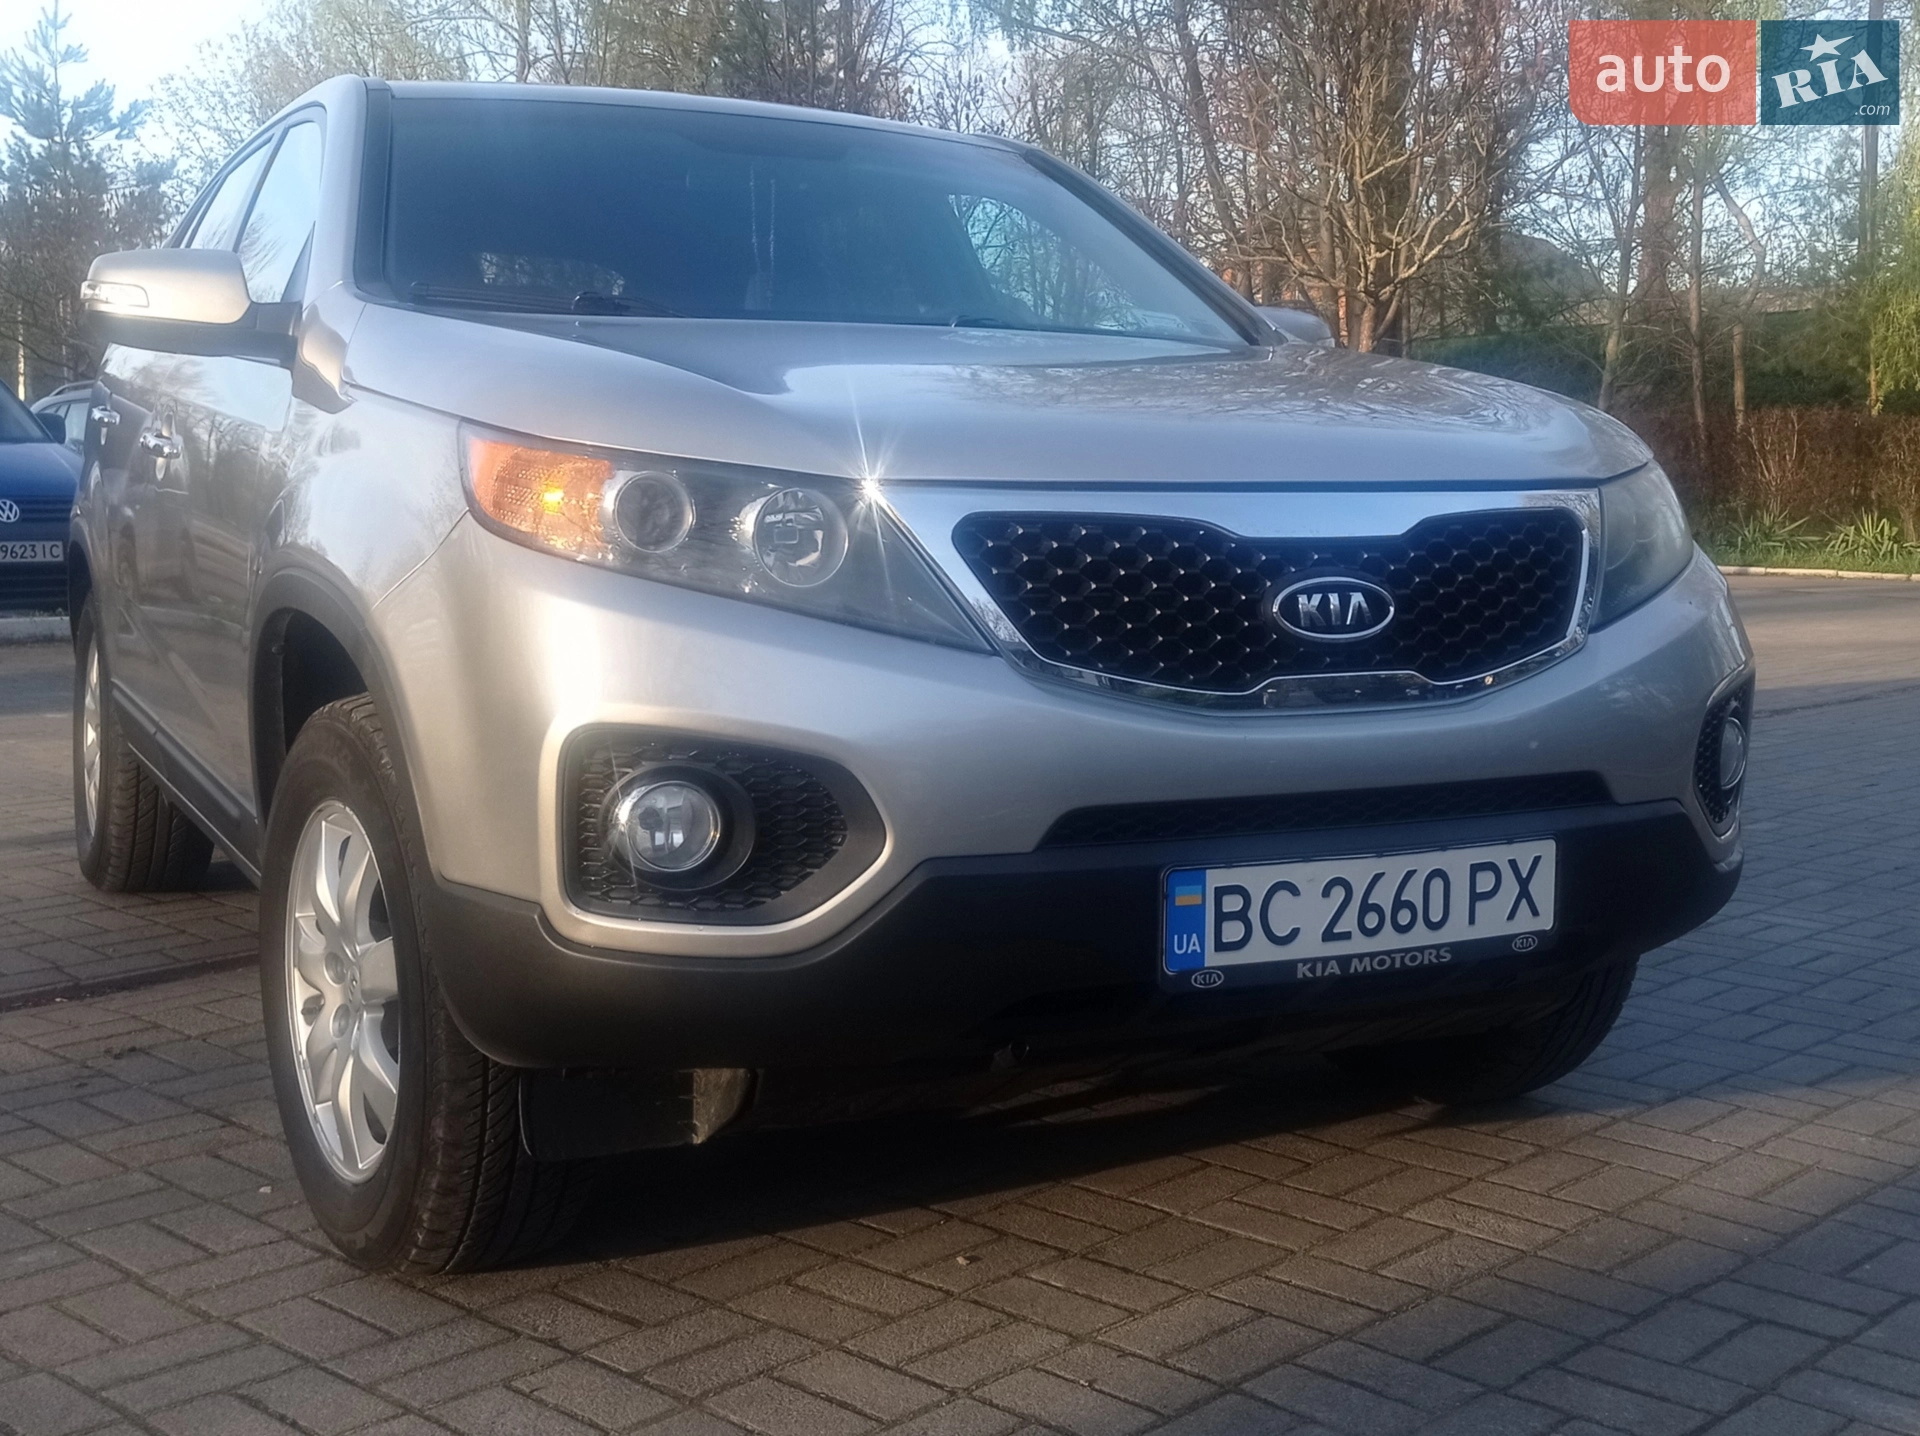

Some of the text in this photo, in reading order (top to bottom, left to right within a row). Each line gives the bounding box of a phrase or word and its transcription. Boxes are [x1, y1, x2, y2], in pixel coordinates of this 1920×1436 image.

[0, 544, 37, 559] 9623
[1297, 592, 1373, 627] KIA
[1213, 855, 1542, 953] BC 2660 PX
[1174, 933, 1201, 955] UA
[1516, 937, 1534, 948] KIA
[1296, 947, 1452, 979] KIA MOTORS
[1196, 973, 1219, 984] KIA
